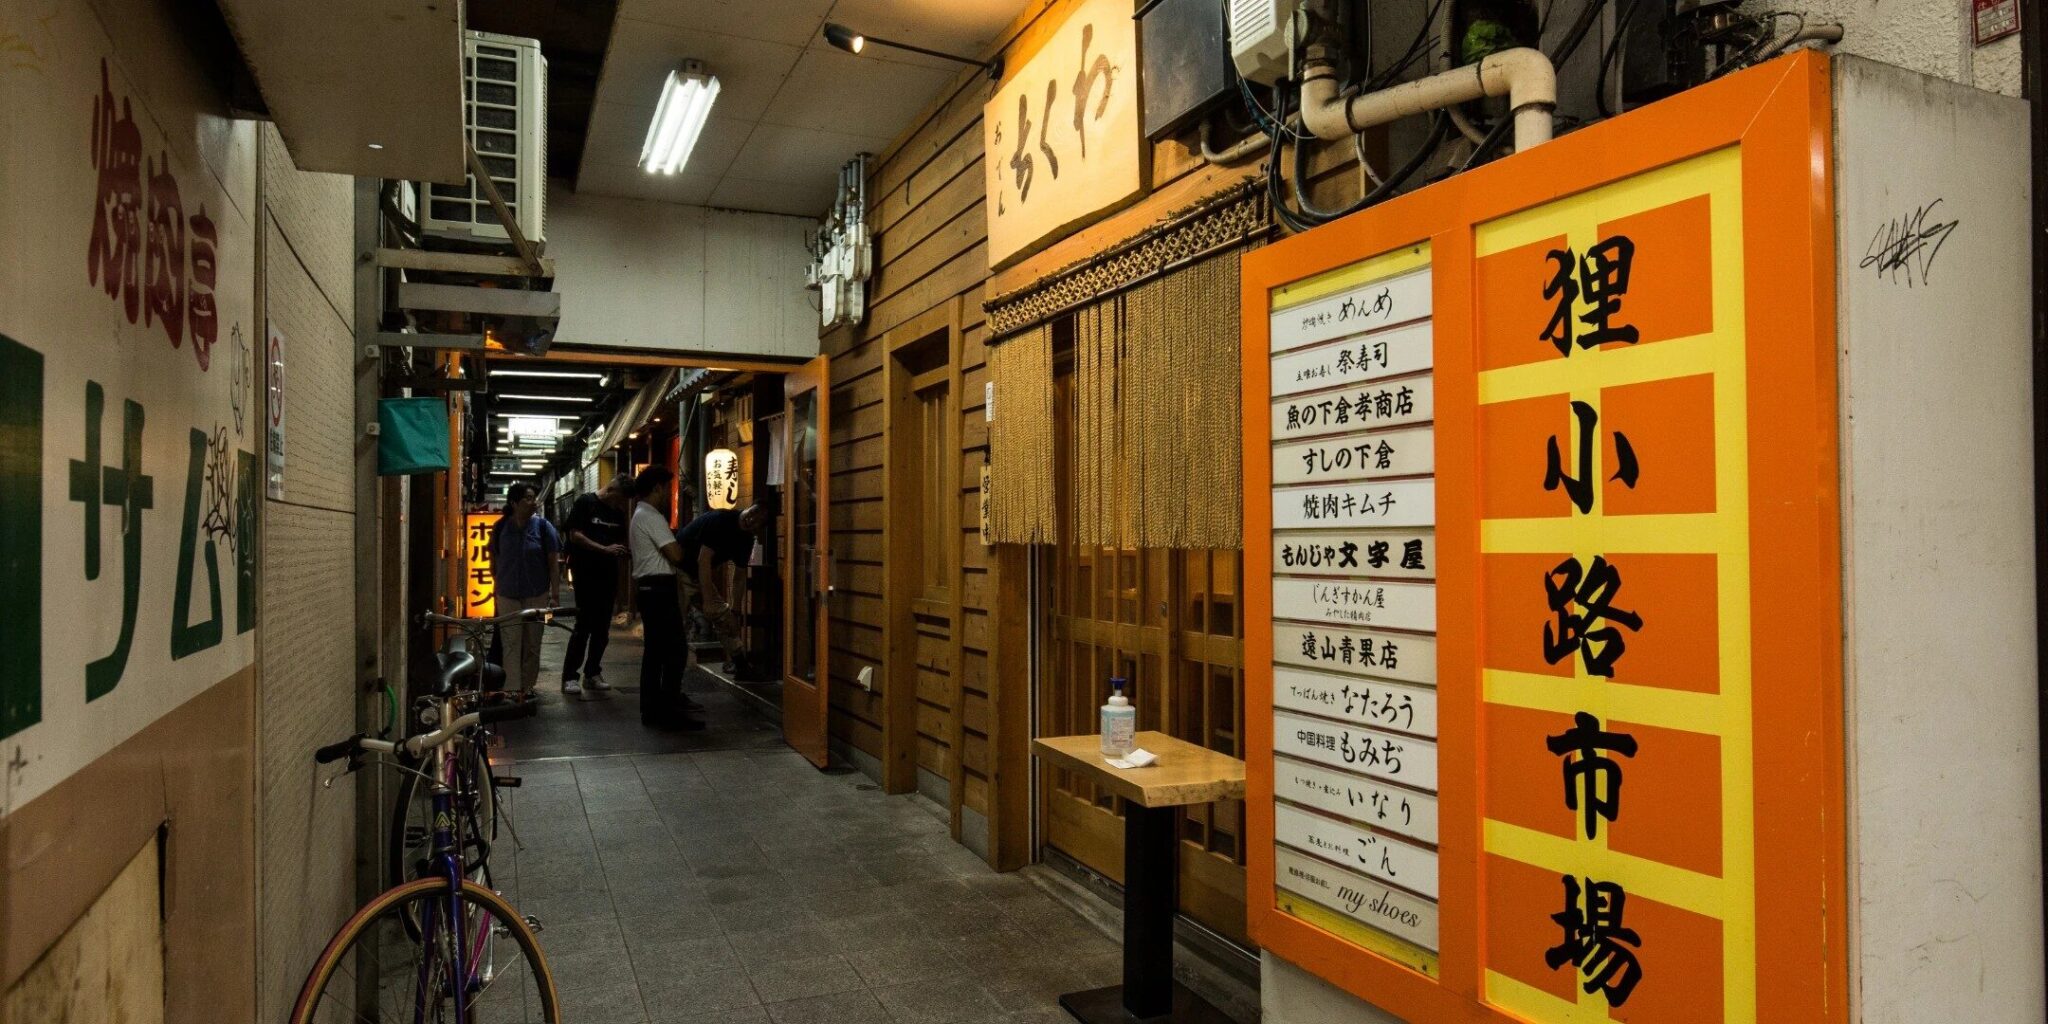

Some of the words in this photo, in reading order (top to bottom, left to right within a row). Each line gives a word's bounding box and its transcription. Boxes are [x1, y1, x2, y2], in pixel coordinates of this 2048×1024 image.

[88, 57, 218, 373] 焼肉亭
[1338, 286, 1393, 322] めんめ
[1336, 341, 1388, 375] 祭寿司
[1286, 386, 1414, 431] 魚の下倉孝商店
[1302, 439, 1395, 475] すしの下倉
[725, 456, 738, 504] 寿し
[1303, 491, 1396, 520] 焼肉キムチ
[470, 522, 494, 608] ホルモン
[1312, 583, 1385, 609] じんぎすかん屋
[1539, 235, 1643, 1008] 狸小路市場
[1302, 631, 1398, 670] 遠山青果店
[1341, 684, 1414, 729] なたろう
[1297, 730, 1336, 752] 中国料理
[1340, 731, 1404, 774] もみぢ
[1347, 787, 1411, 826] いなり
[1357, 836, 1396, 877] ごん
[1337, 885, 1367, 914] my
[1369, 890, 1422, 928] shoes
